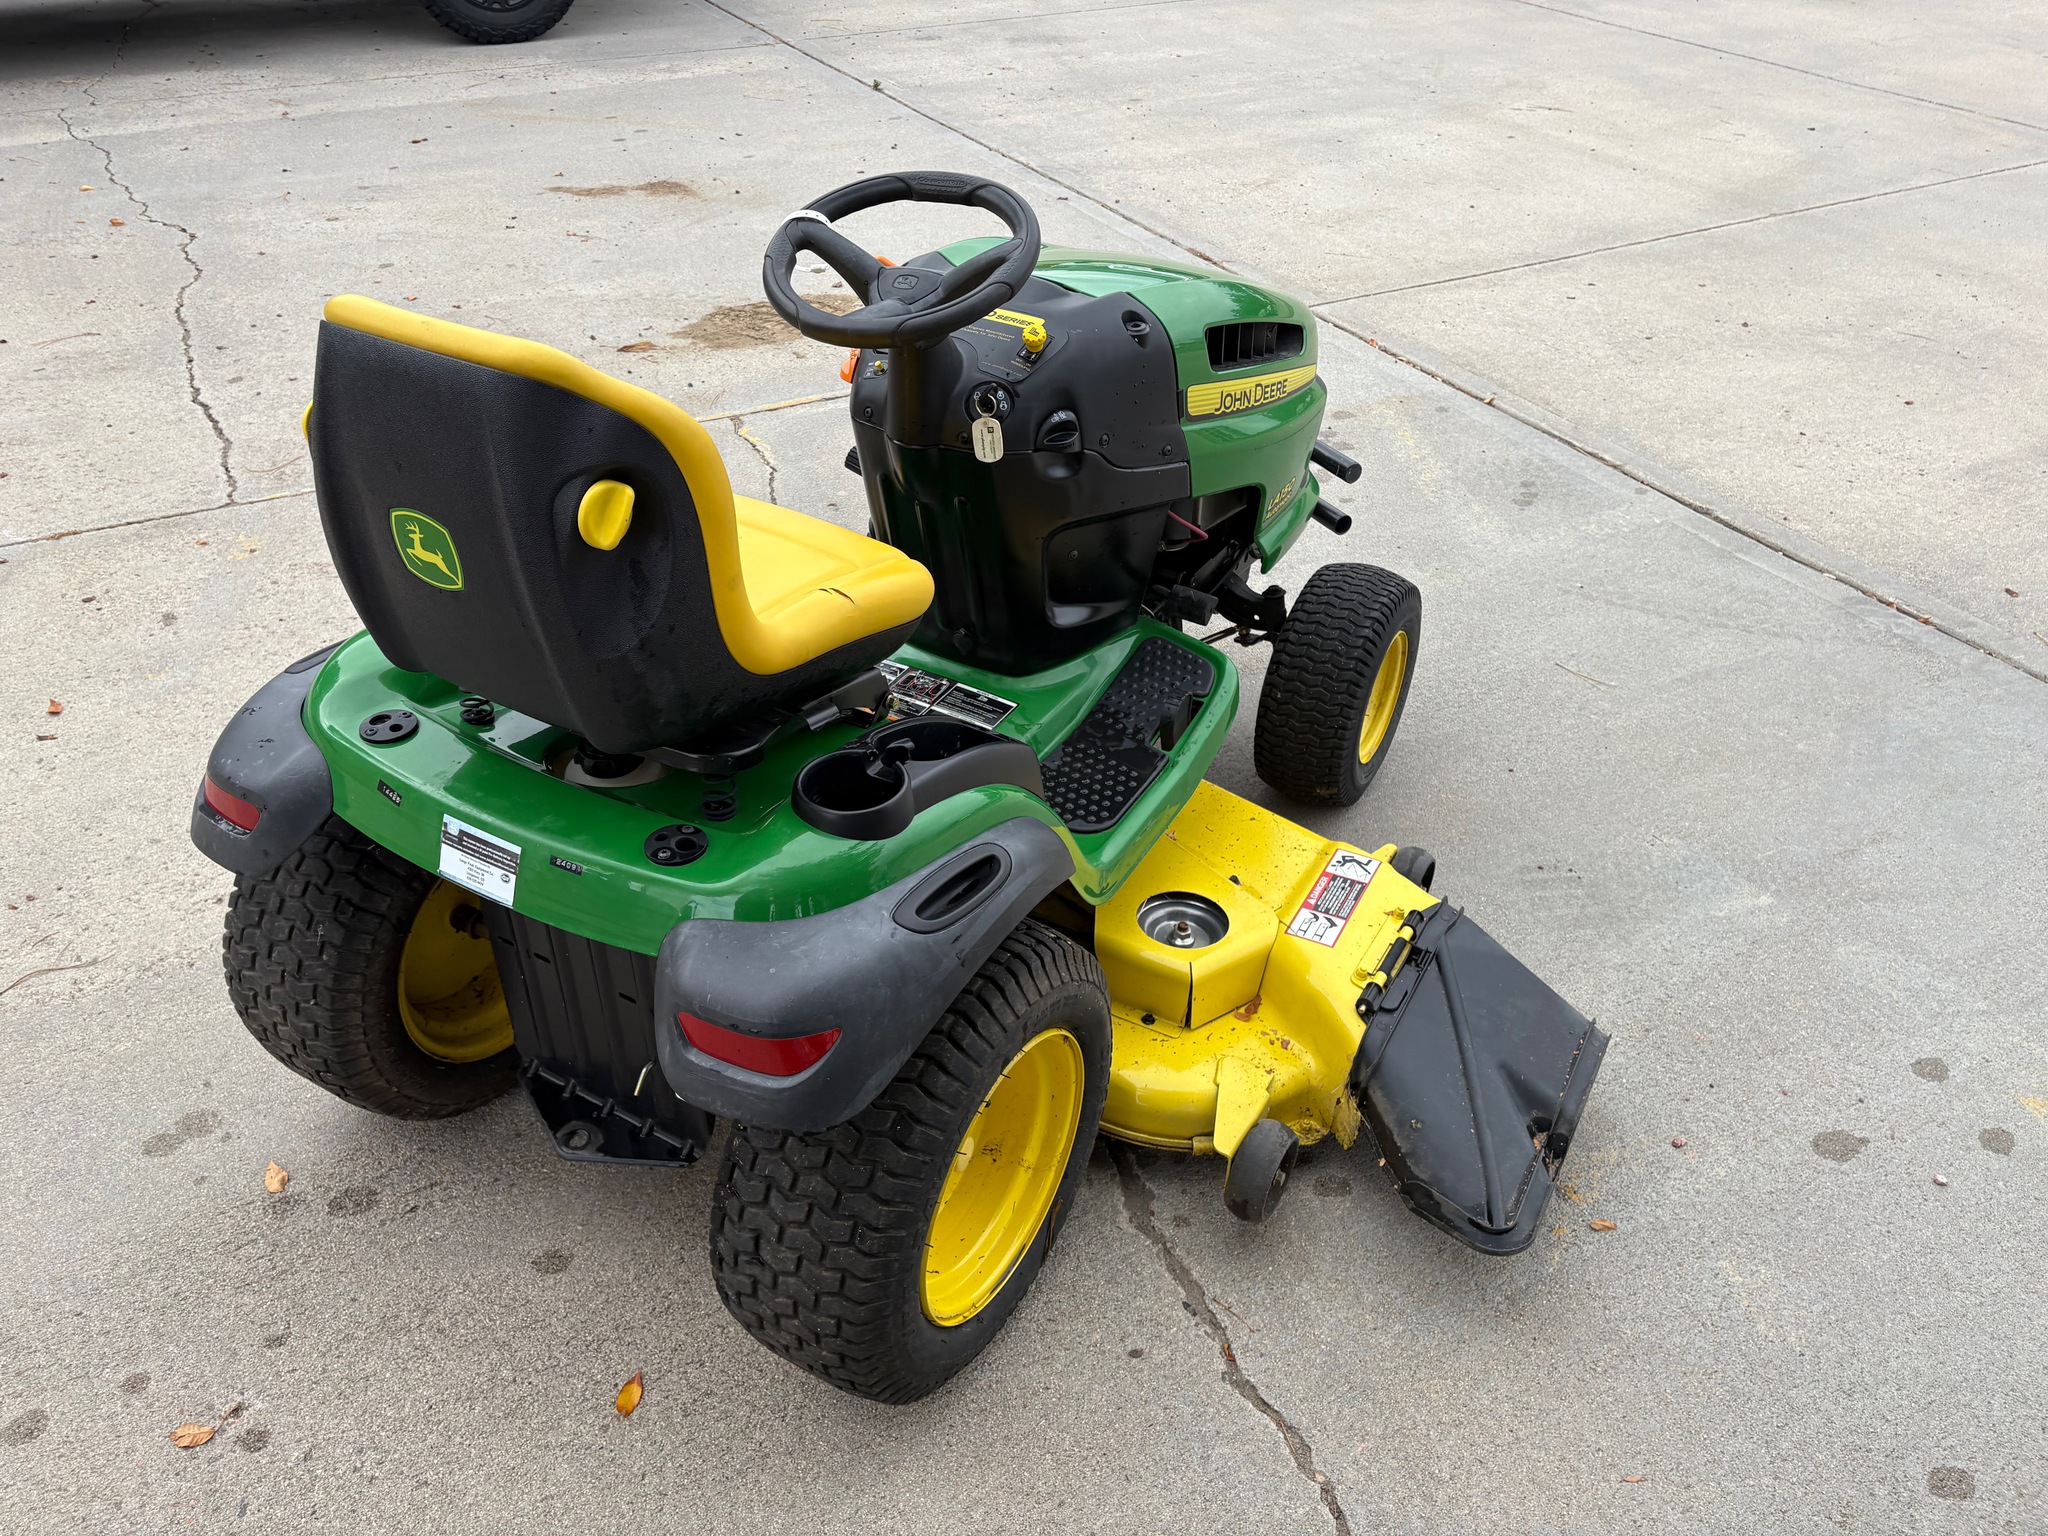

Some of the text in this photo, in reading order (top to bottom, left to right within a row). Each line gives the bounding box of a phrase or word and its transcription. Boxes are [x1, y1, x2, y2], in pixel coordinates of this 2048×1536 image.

[1214, 379, 1288, 412] JOHN DEERE
[1311, 876, 1329, 899] DANGER
